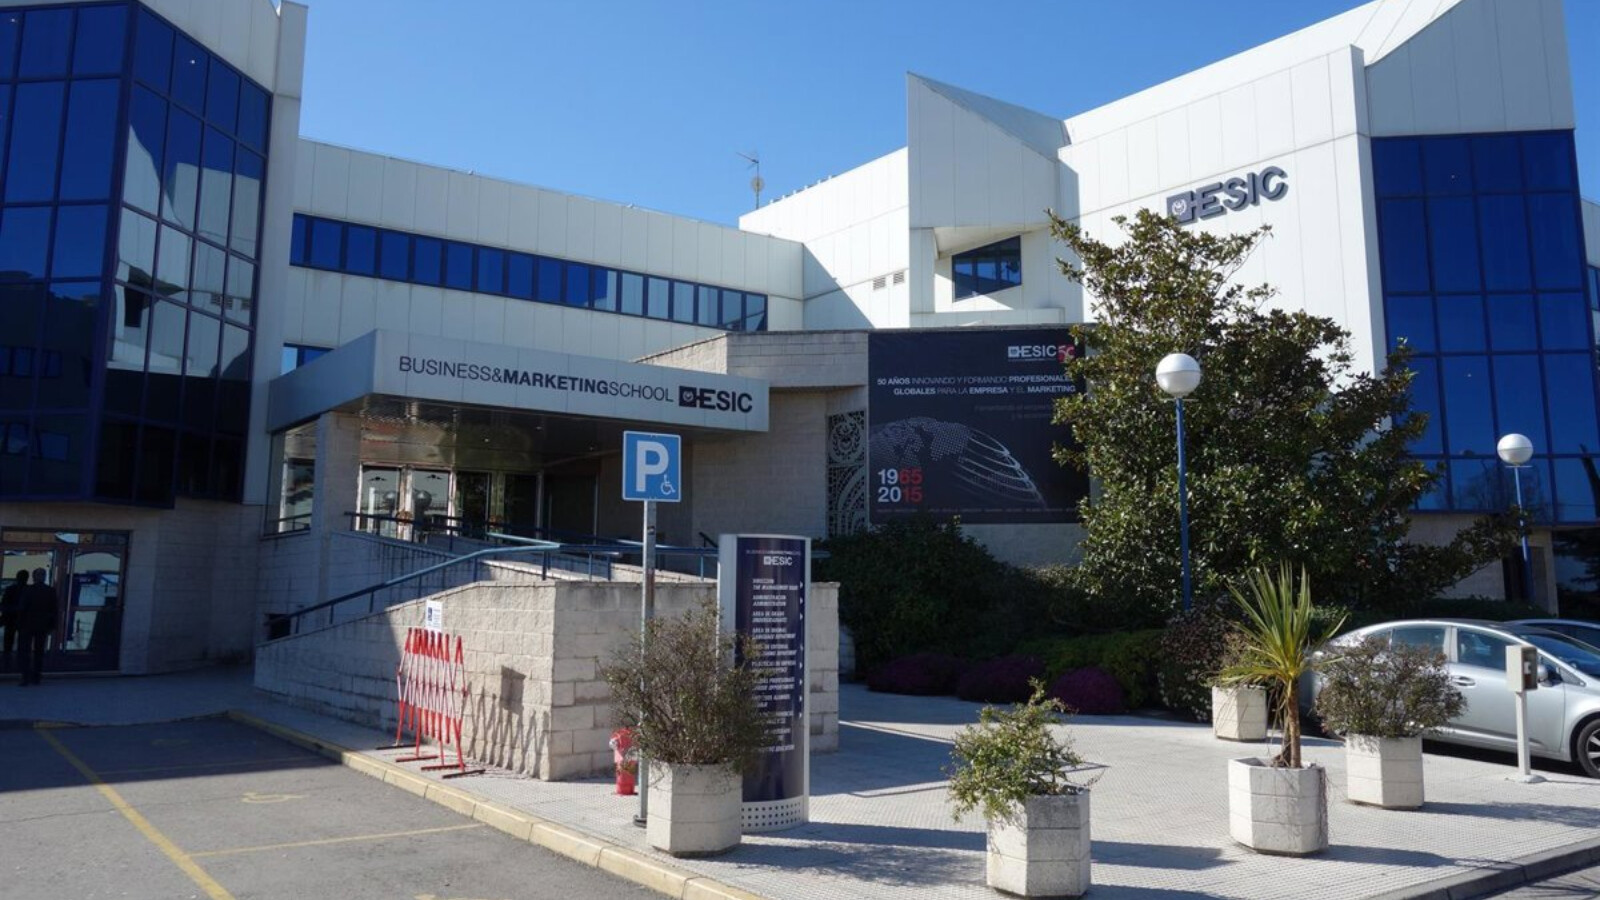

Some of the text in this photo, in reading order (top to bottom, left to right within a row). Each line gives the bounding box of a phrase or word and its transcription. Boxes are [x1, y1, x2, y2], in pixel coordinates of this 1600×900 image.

[1195, 166, 1289, 220] ESIC
[1021, 345, 1057, 358] ESIC
[399, 356, 753, 413] BUSINESS&MARKETINGSCHOOL ESIC
[877, 377, 887, 385] 50
[887, 376, 911, 385] AÑOS
[956, 376, 963, 384] Y
[963, 376, 1008, 384] FORMANDO
[893, 387, 936, 395] GLOBALES
[969, 386, 1009, 395] EMPRESA
[1027, 385, 1076, 393] MARKETING
[635, 440, 669, 492] P
[878, 468, 922, 484] 1965
[878, 486, 922, 503] 2015
[772, 556, 792, 566] ESIC
